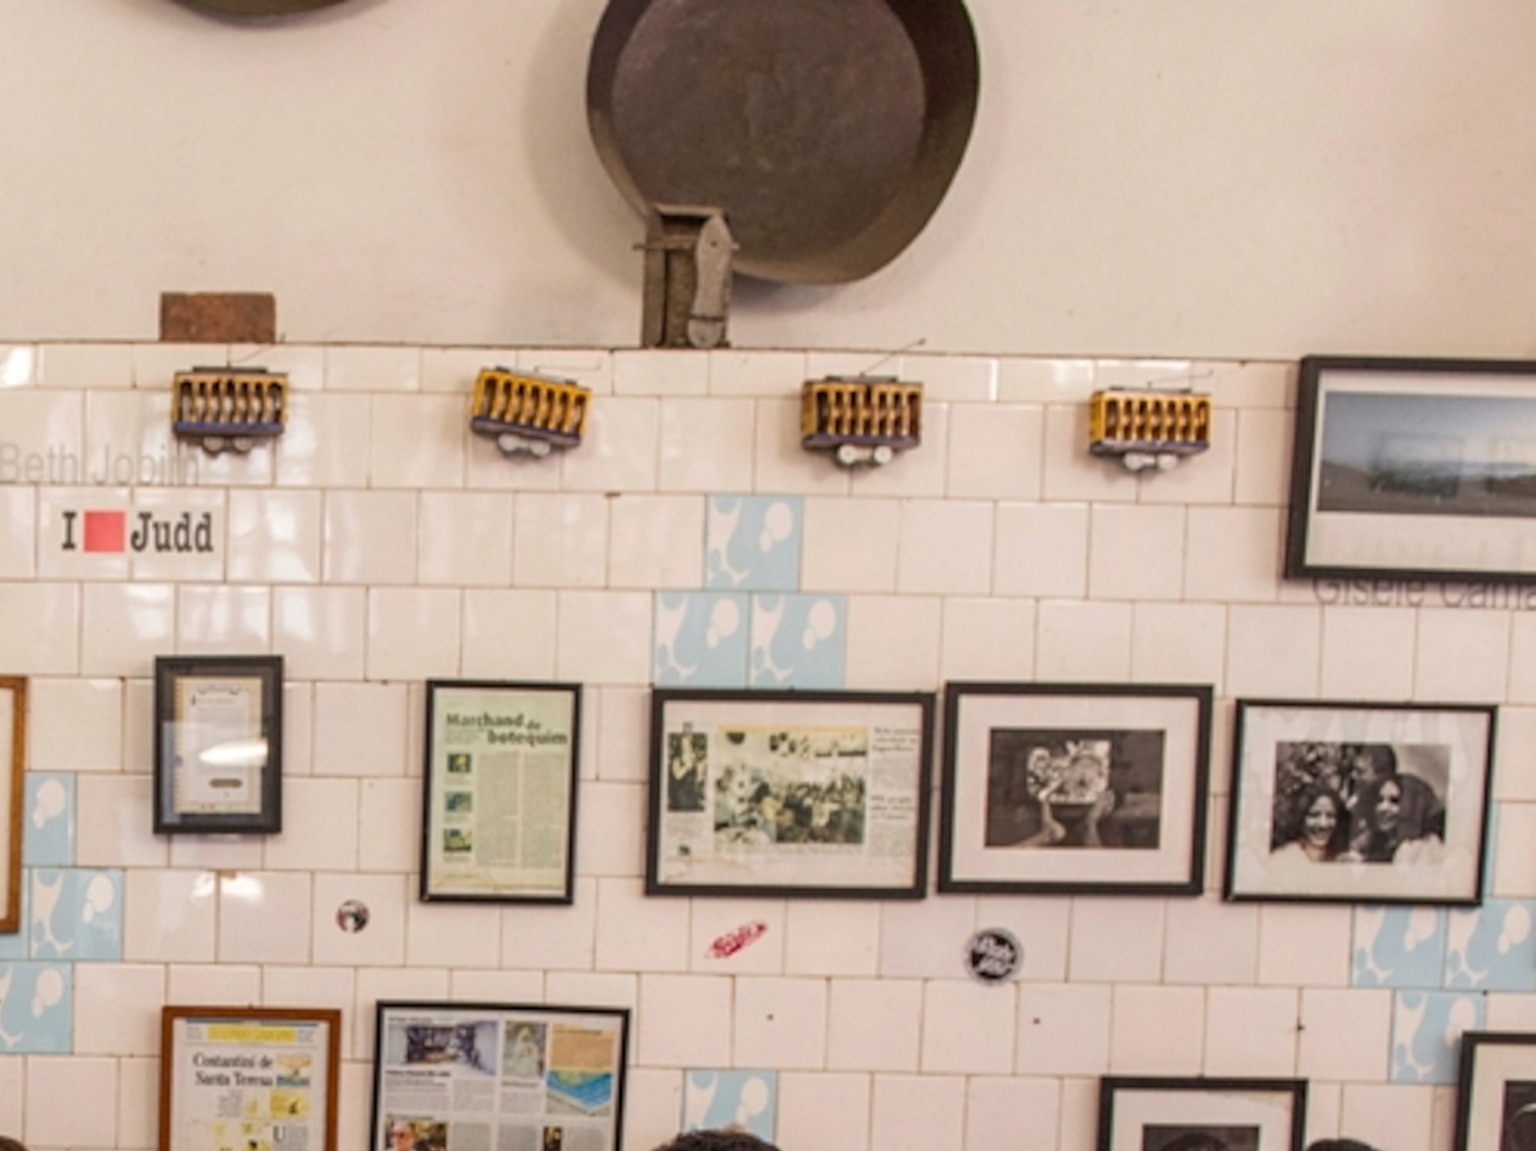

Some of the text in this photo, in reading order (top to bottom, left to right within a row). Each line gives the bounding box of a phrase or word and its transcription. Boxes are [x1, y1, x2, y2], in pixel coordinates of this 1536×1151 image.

[62, 511, 214, 552] I Judd
[446, 712, 524, 729] Marchand
[487, 729, 568, 747] botequim
[195, 1070, 230, 1086] Santa
